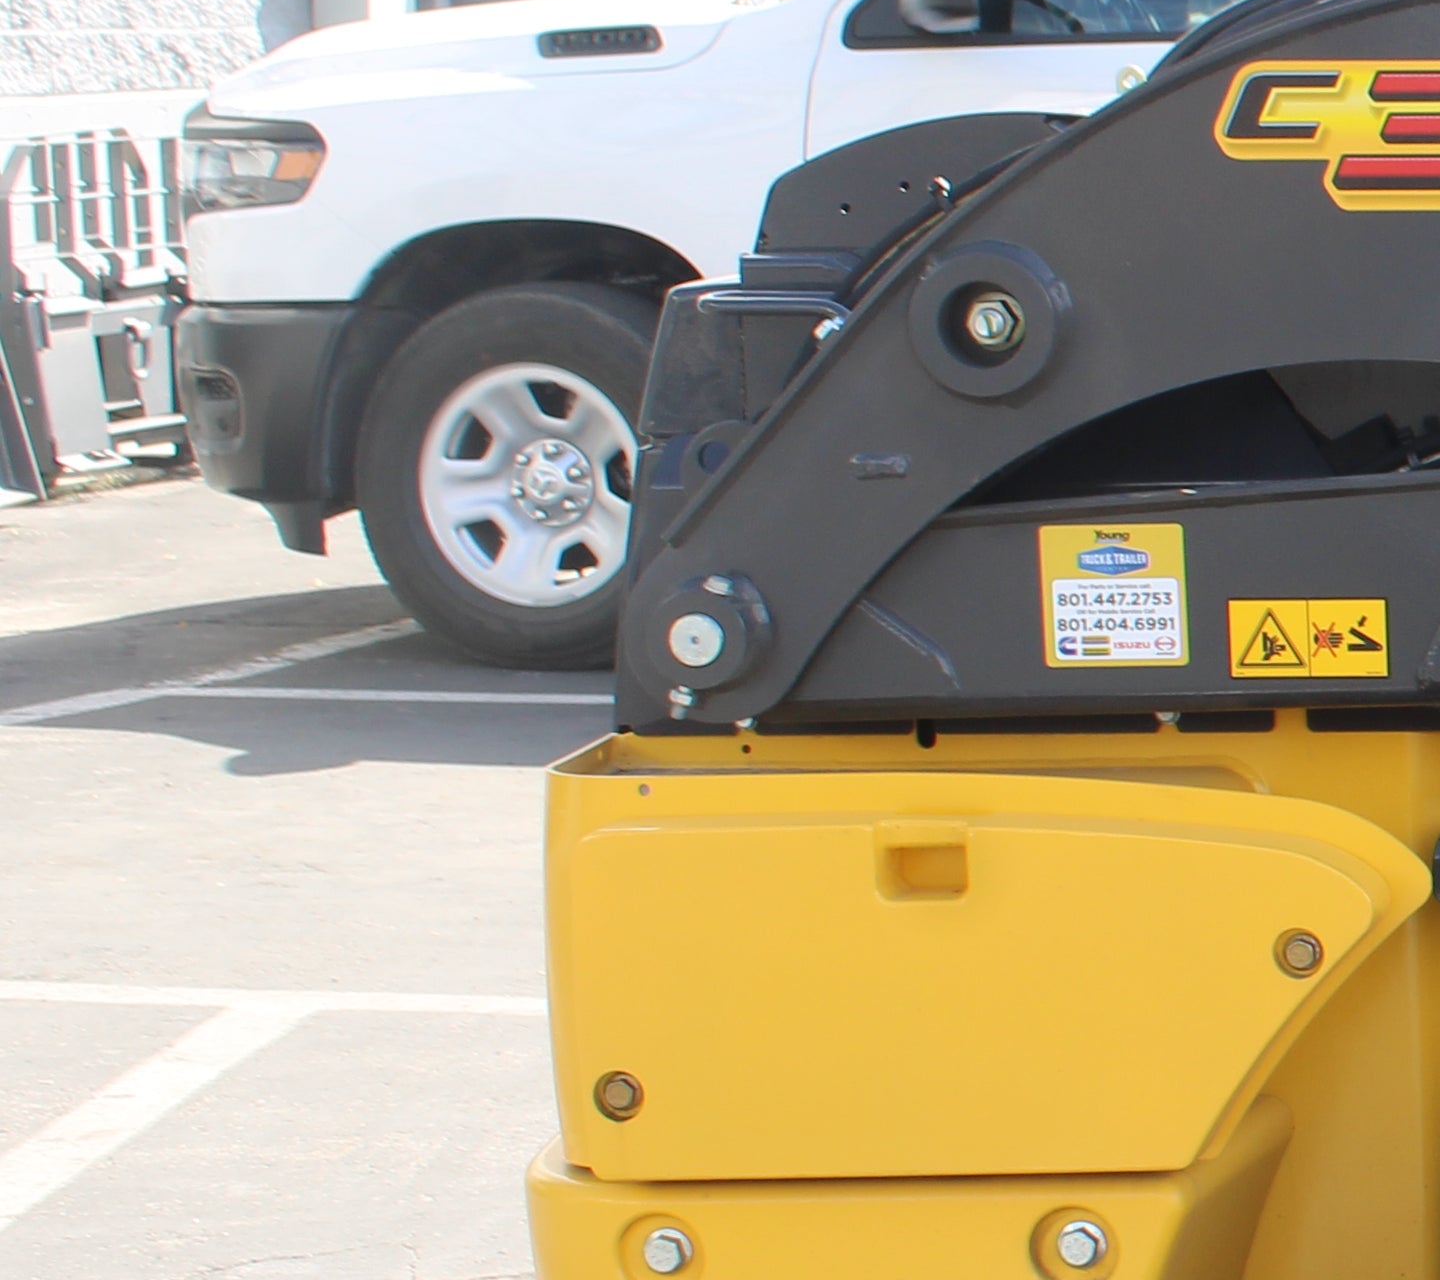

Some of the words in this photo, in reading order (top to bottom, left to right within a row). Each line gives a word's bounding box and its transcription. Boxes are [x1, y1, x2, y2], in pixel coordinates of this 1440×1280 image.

[1094, 529, 1130, 542] Young
[1114, 553, 1147, 565] TRAILER
[1057, 592, 1174, 607] 801.447.2753
[1057, 617, 1176, 632] 801.404.6991
[1113, 641, 1151, 649] ISUZU
